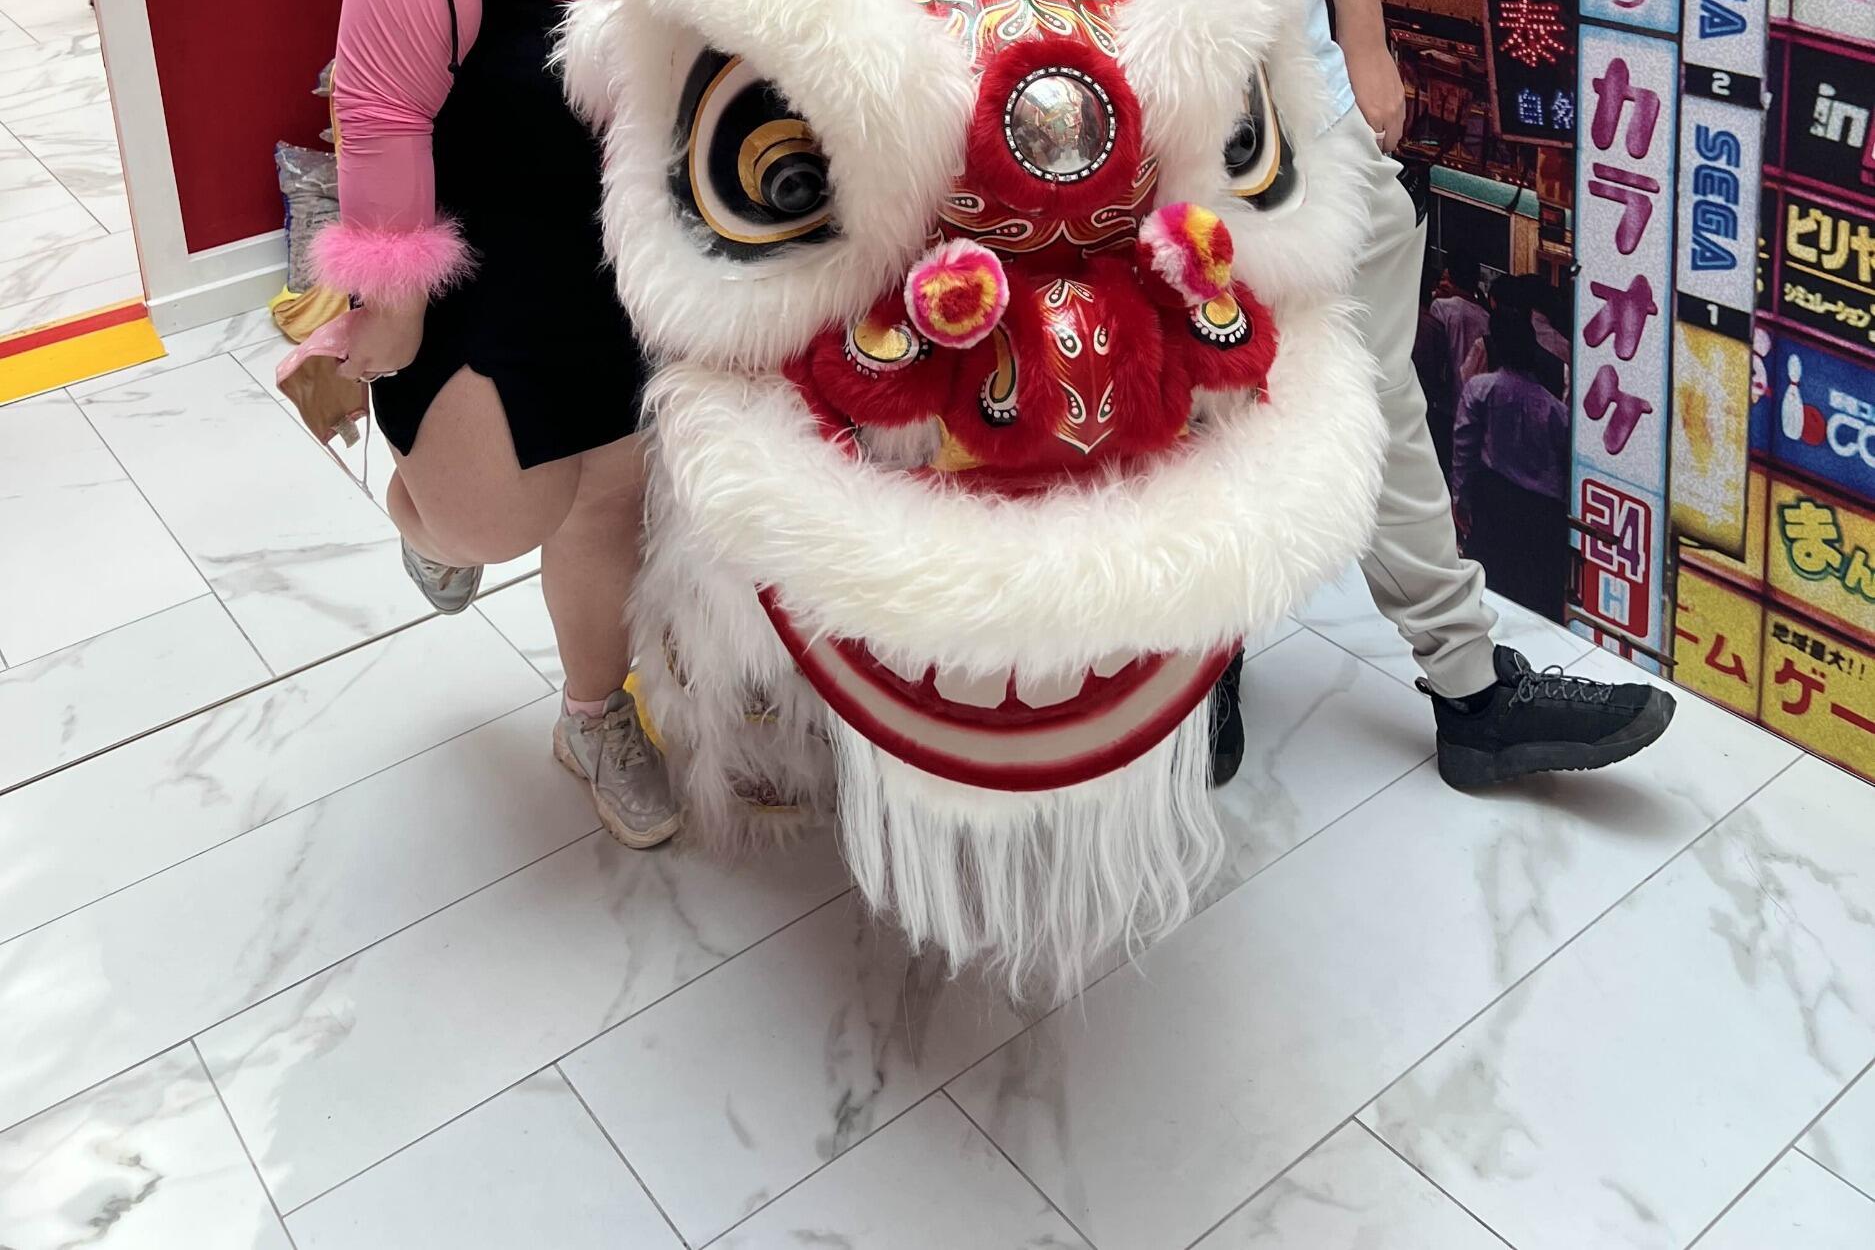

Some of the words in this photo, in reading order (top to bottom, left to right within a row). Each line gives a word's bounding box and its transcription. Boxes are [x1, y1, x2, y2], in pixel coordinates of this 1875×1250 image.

[1583, 57, 1661, 456] カラオケ
[1691, 123, 1741, 273] SEGA
[1707, 303, 1719, 327] 1
